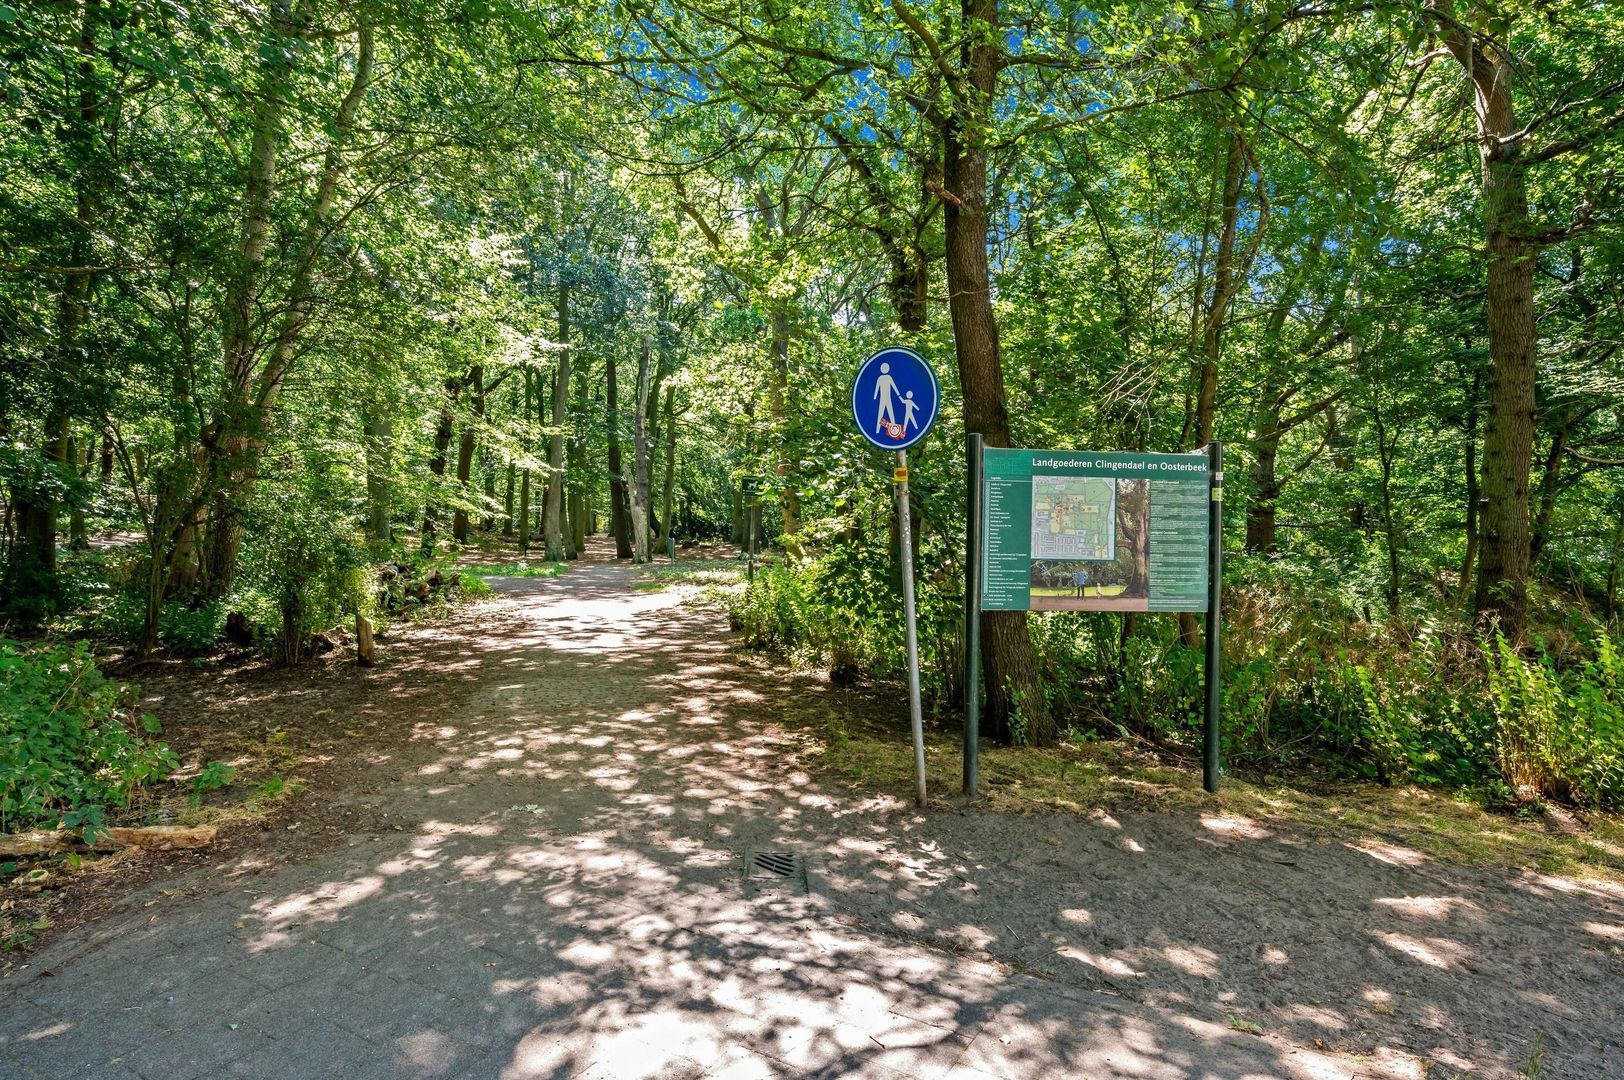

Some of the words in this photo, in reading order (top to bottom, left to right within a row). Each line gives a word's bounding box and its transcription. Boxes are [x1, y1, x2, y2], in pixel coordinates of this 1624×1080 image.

[1032, 458, 1092, 469] Landgoederen
[1095, 460, 1145, 471] Clingendael
[1160, 462, 1207, 472] Oosterbeek
